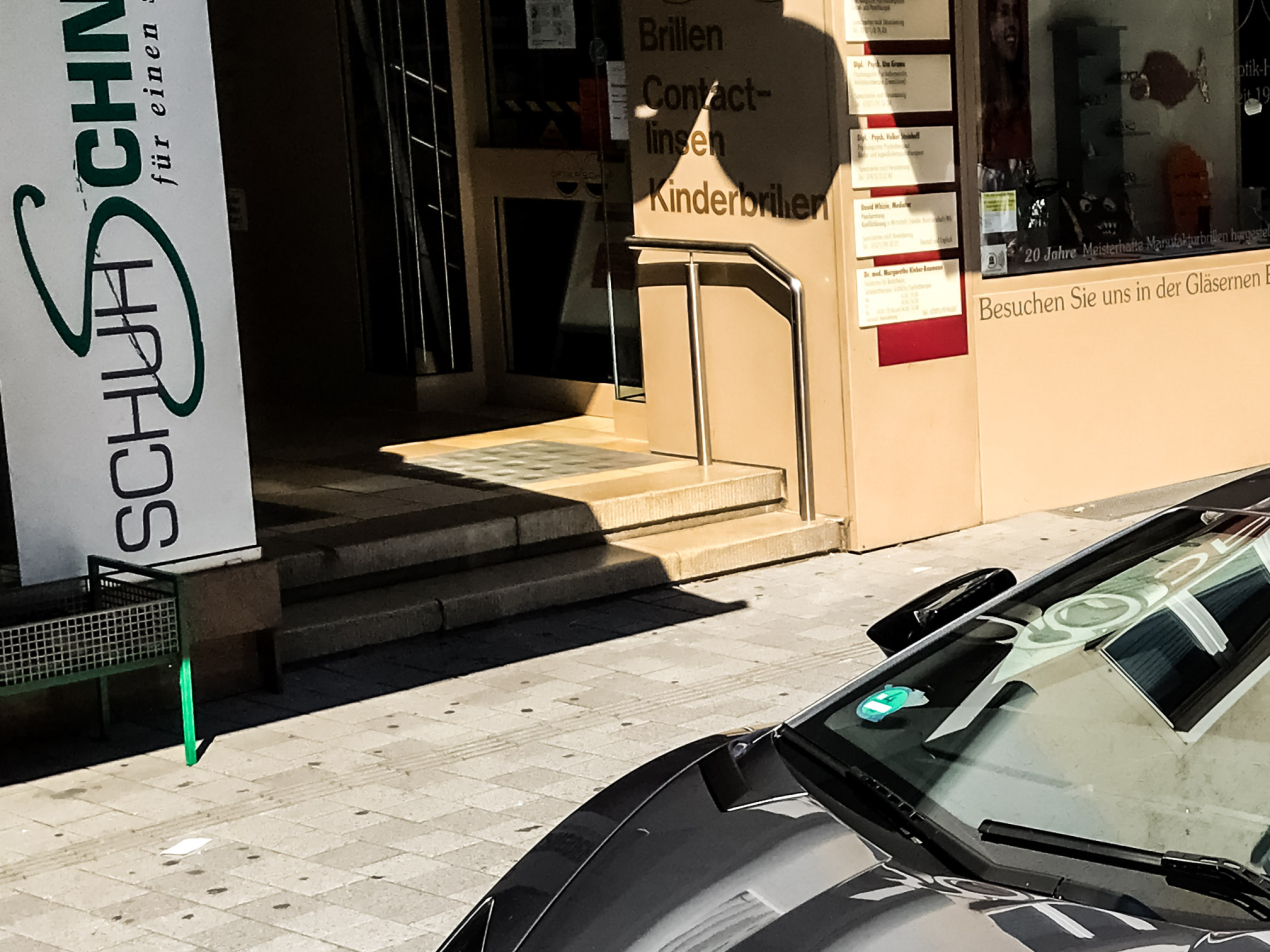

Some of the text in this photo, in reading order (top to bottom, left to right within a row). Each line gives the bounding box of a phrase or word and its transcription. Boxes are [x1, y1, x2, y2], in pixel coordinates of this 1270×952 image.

[639, 16, 723, 51] Brillen
[143, 23, 166, 116] einen
[643, 75, 772, 111] Contact-
[645, 120, 725, 156] linsen
[151, 135, 178, 186] für
[650, 178, 829, 220] Kinderbrillen
[1024, 248, 1042, 263] 20
[1043, 245, 1077, 261] Jahre
[1082, 237, 1143, 257] Meisterhafte
[979, 291, 1065, 321] Besuchen
[1070, 285, 1097, 310] Sie
[1103, 285, 1131, 305] uns
[1136, 280, 1151, 302] in
[1156, 276, 1182, 299] der
[1186, 271, 1260, 296] Gläsernen
[93, 259, 179, 552] SCHUH
